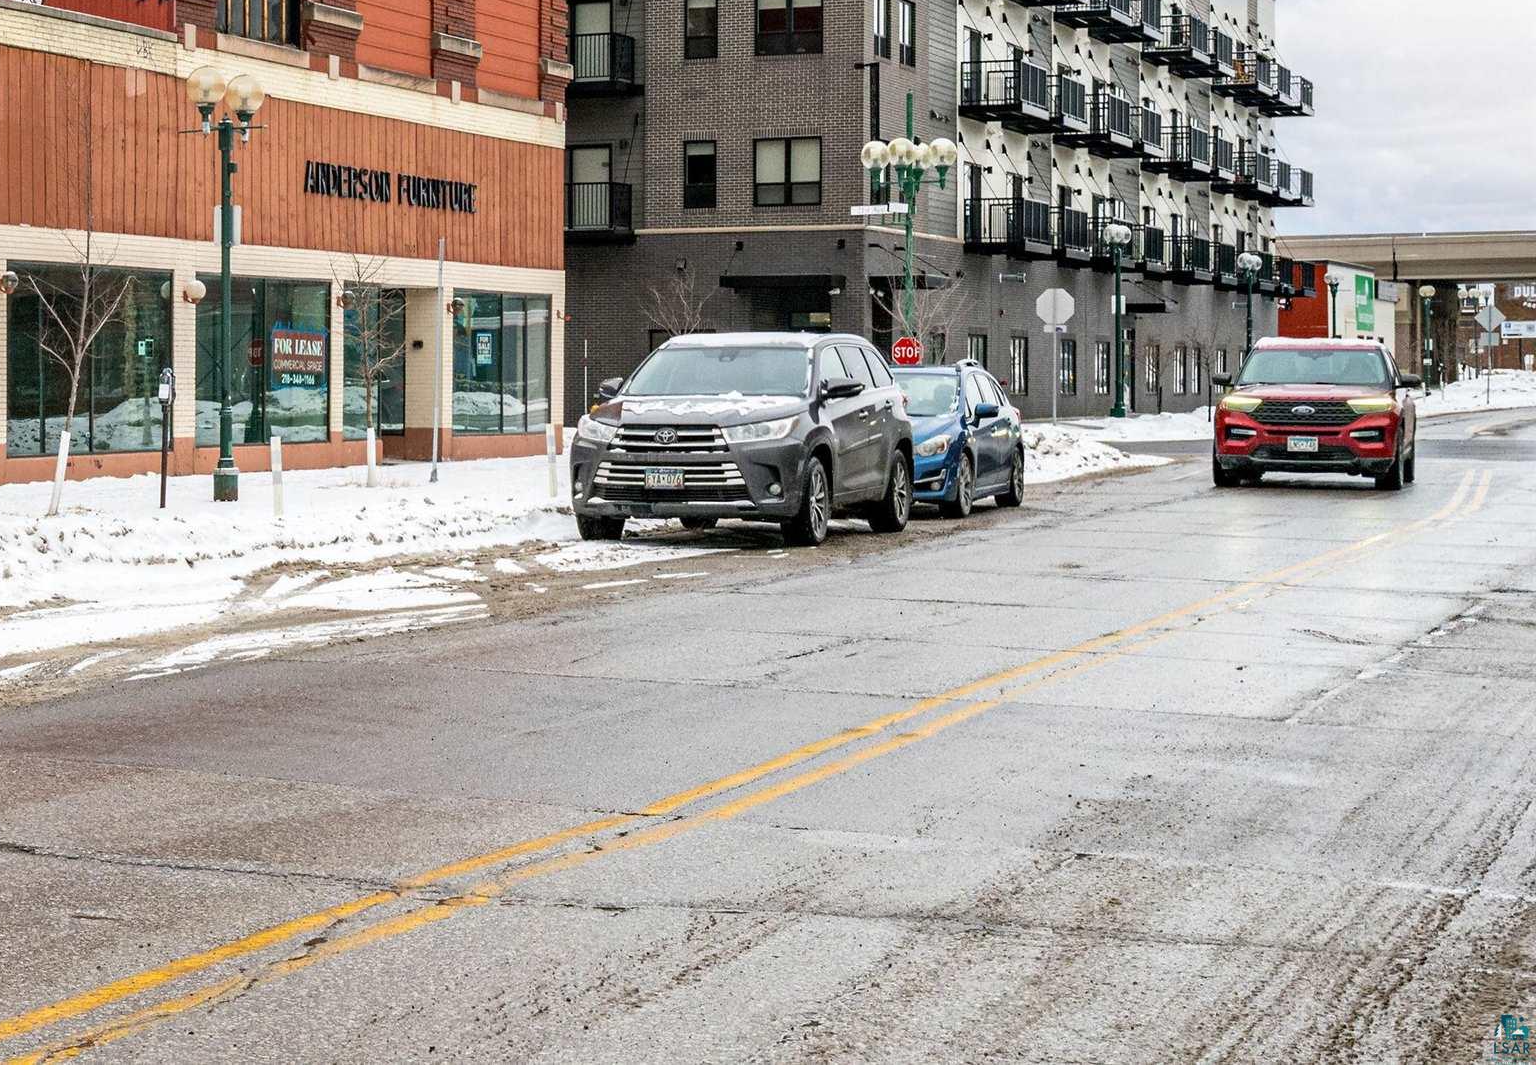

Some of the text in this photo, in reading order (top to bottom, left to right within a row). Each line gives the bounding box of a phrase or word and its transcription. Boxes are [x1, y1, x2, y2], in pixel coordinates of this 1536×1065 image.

[304, 160, 477, 215] ANDERSON FURNITURE
[274, 338, 323, 357] FOR LEASE
[307, 361, 323, 372] SPACE
